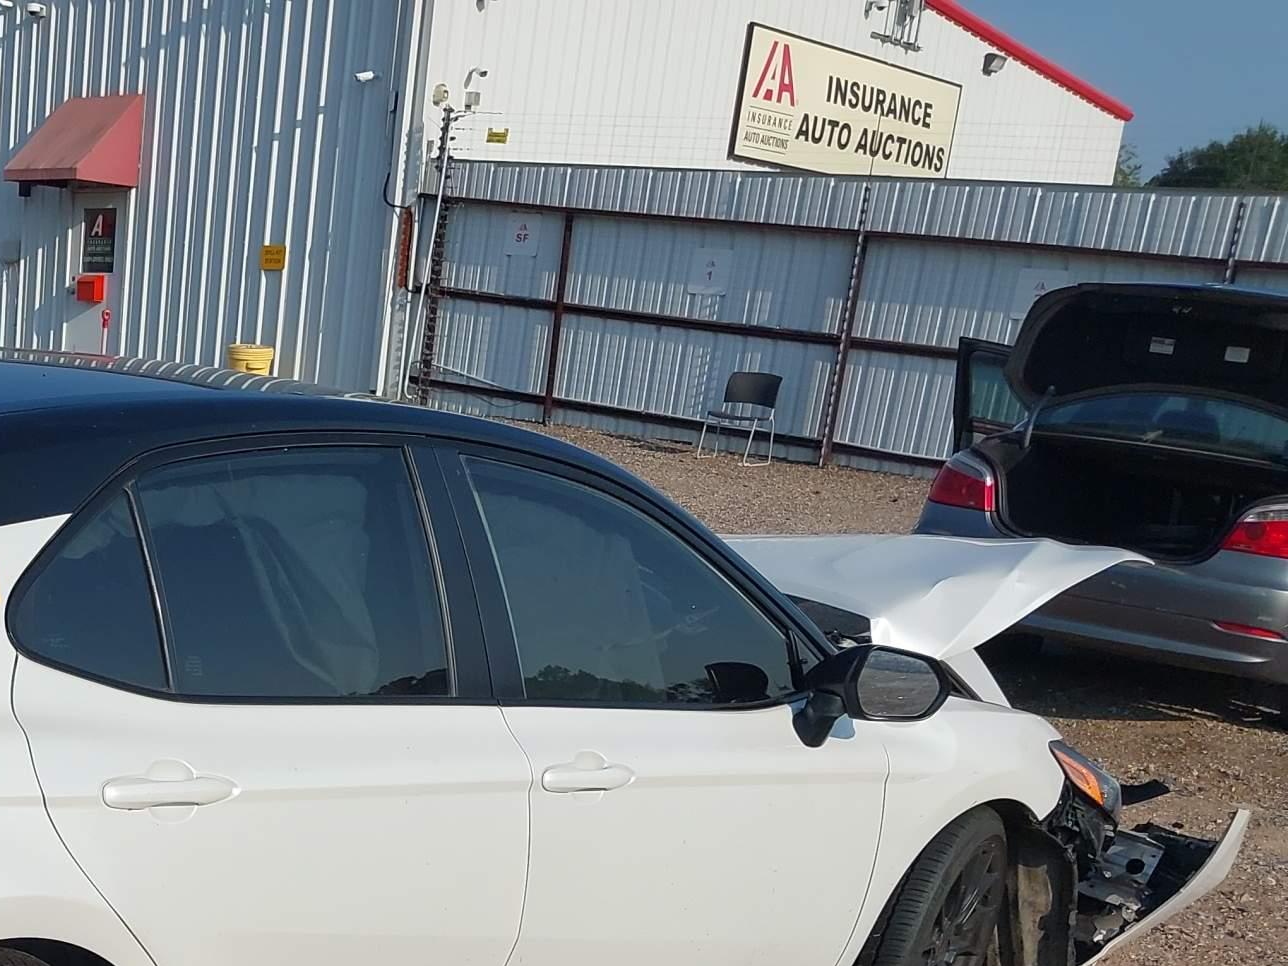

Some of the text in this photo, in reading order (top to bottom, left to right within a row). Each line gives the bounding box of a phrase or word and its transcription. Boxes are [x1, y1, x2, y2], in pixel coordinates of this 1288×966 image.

[826, 75, 933, 129] INSURANCE
[747, 111, 793, 131] INSURANCE
[744, 130, 790, 150] AUTO AUCTIONS
[795, 113, 945, 173] AUTO AUCTIONS
[515, 233, 529, 243] SF
